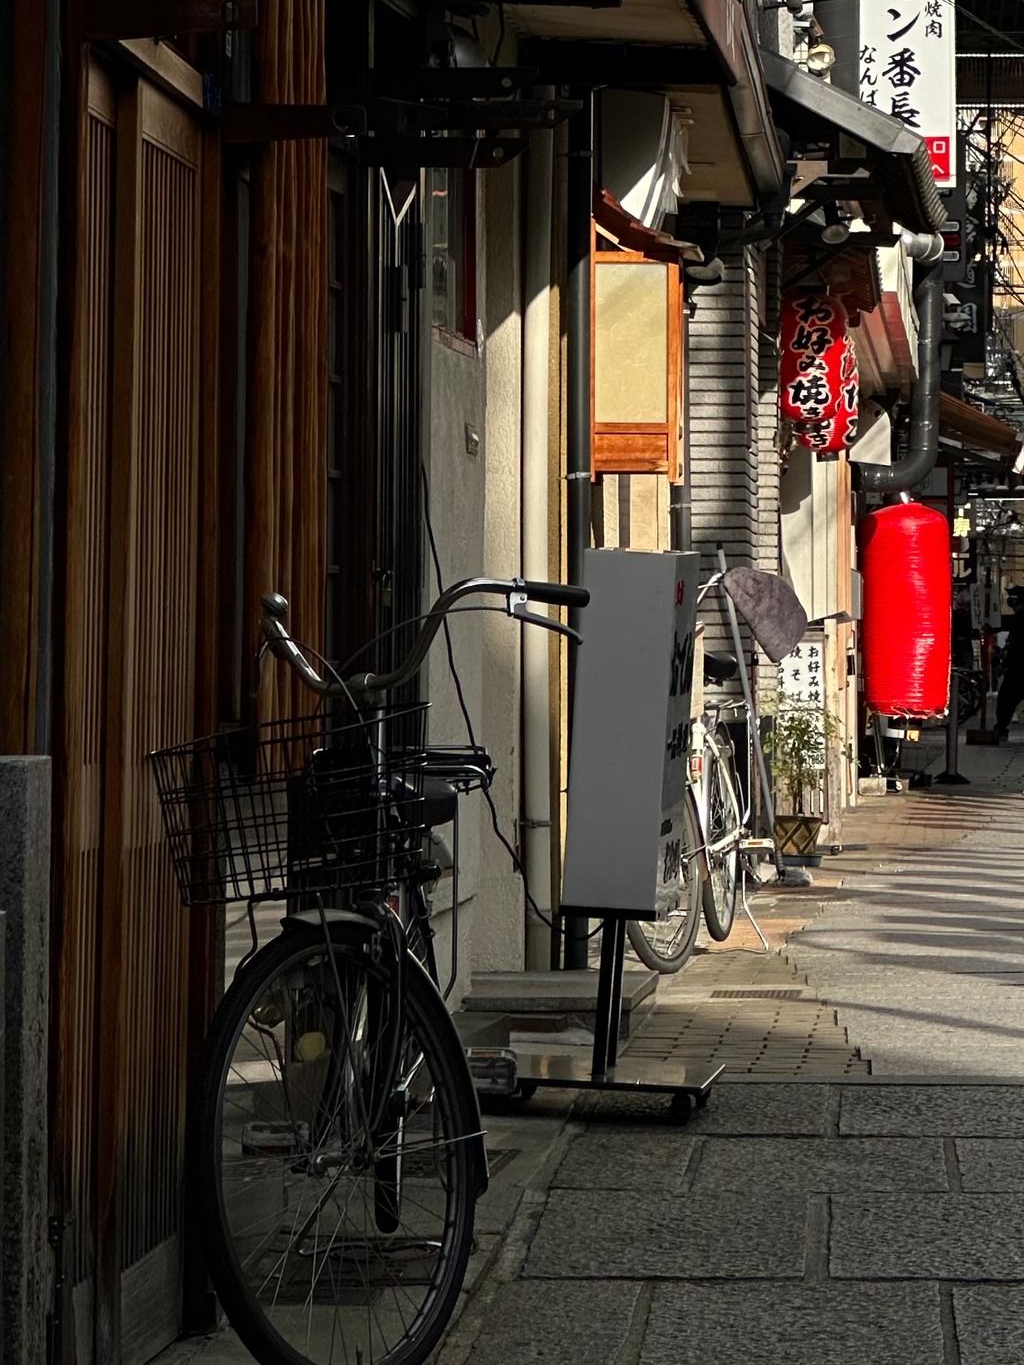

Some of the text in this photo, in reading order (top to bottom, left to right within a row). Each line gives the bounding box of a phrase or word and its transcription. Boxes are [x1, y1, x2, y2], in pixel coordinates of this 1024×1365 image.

[788, 298, 835, 420] お好み焼き
